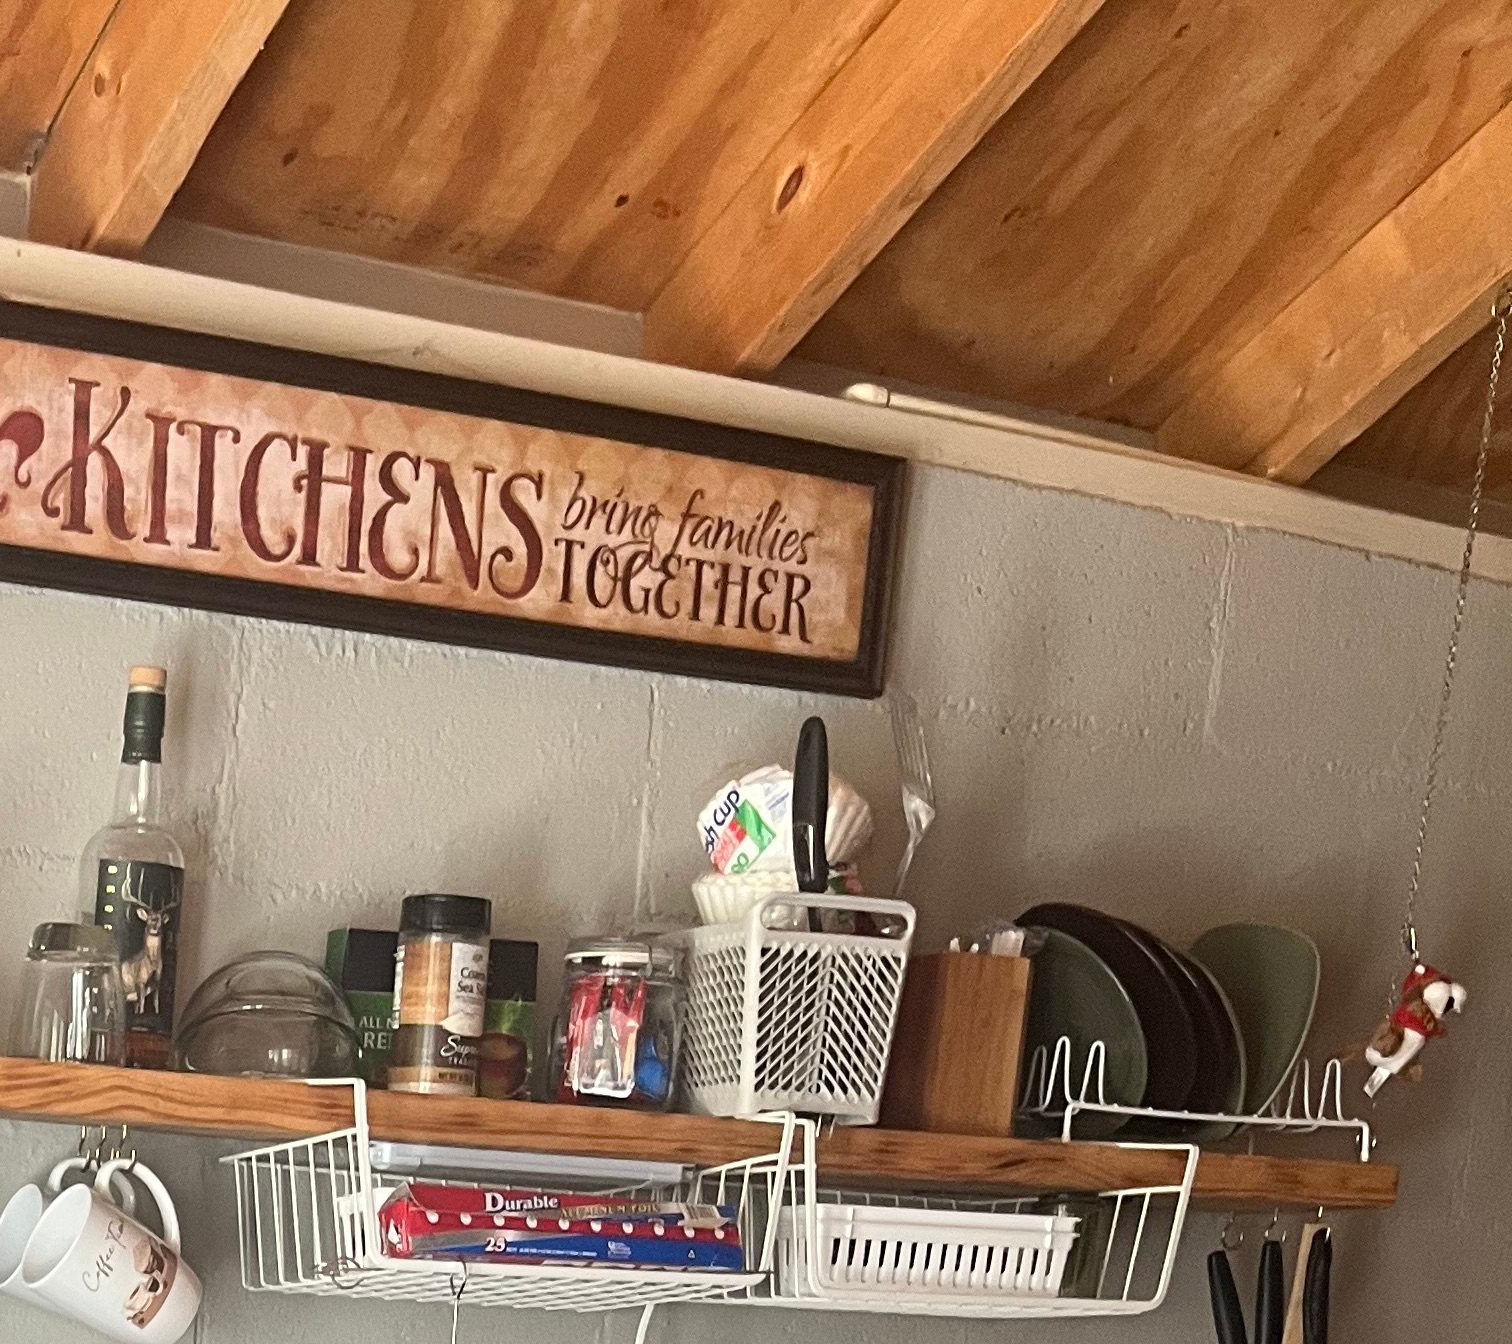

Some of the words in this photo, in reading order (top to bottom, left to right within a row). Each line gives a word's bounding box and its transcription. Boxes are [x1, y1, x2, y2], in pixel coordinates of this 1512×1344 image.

[42, 377, 545, 601] KITCHENS
[560, 470, 665, 572] bring
[671, 488, 816, 566] families
[554, 536, 812, 645] TOGETHER
[359, 1015, 384, 1029] ALL
[484, 1191, 559, 1213] Durable
[484, 1236, 507, 1253] 25
